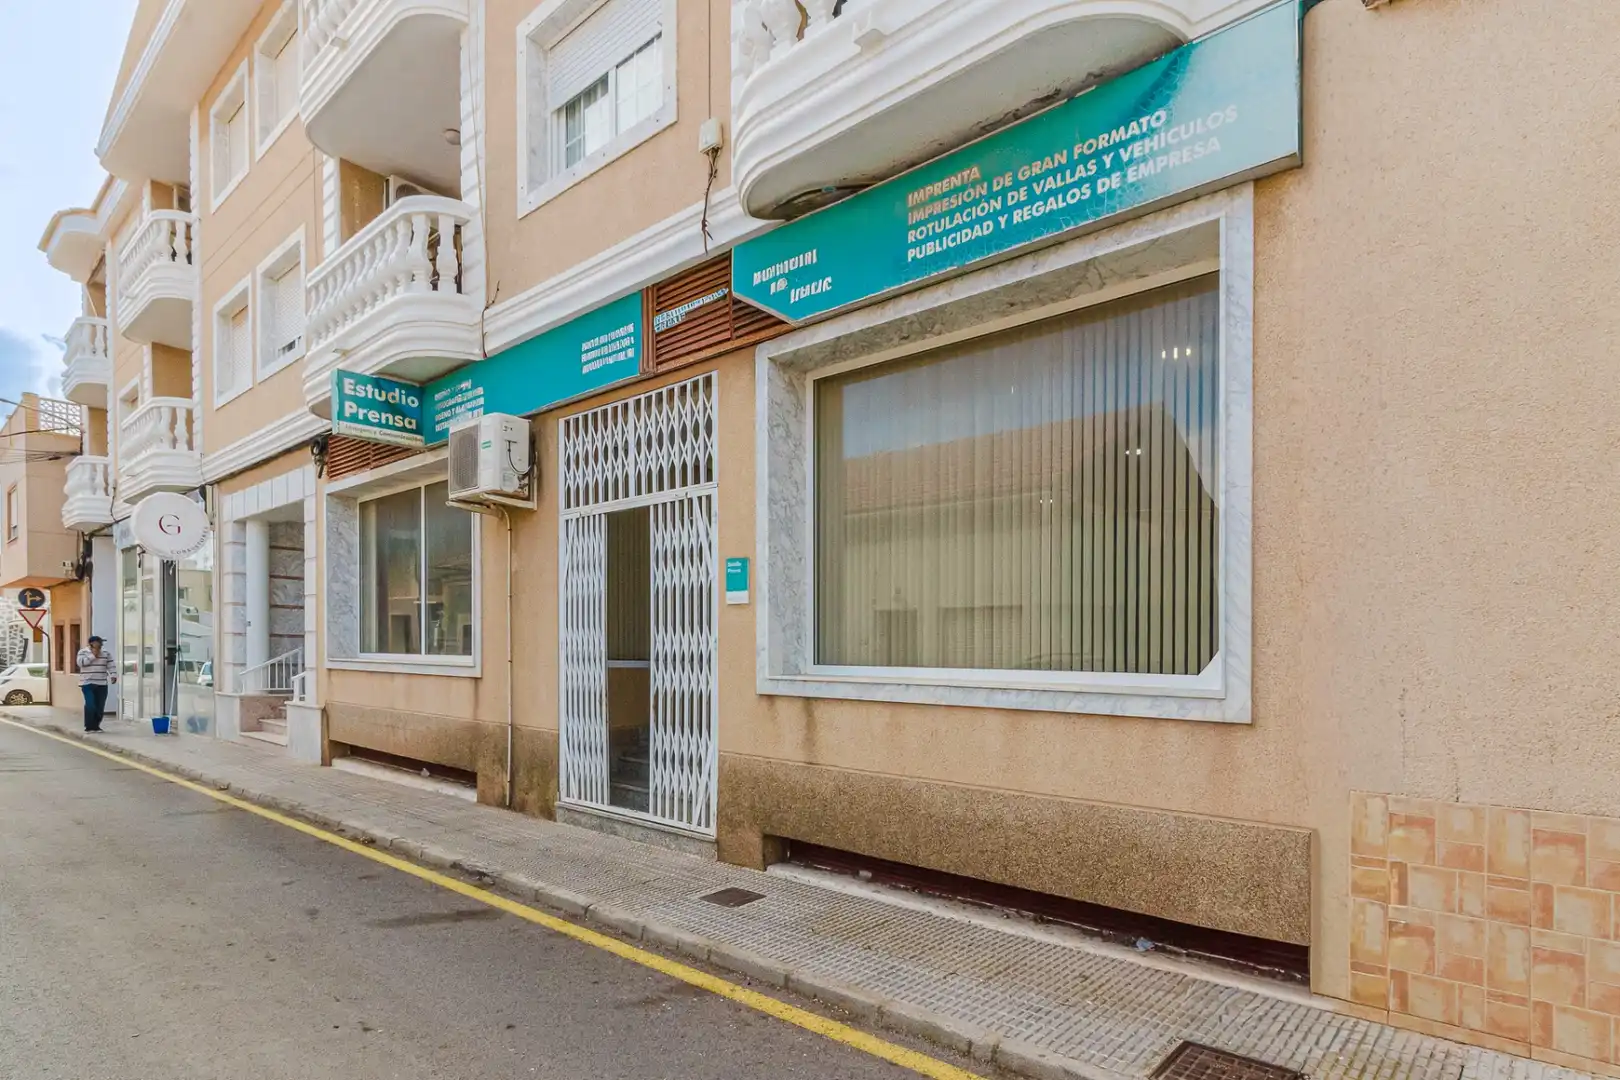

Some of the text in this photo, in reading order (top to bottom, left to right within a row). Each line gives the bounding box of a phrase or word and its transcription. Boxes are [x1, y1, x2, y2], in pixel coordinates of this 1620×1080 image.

[908, 109, 1167, 226] IMPRESIÓN DE GRAN FORMATO
[908, 165, 981, 208] IMPRENTA
[907, 195, 1002, 244] ROTULACIÓN
[1007, 186, 1028, 207] DE
[1032, 158, 1098, 195] VALLAS
[1102, 151, 1115, 169] Y
[907, 136, 1222, 262] PUBLICIDAD Y REGALOS DE EMPRESA
[343, 377, 420, 408] Estudio
[343, 400, 418, 430] Prensa
[158, 513, 181, 536] G
